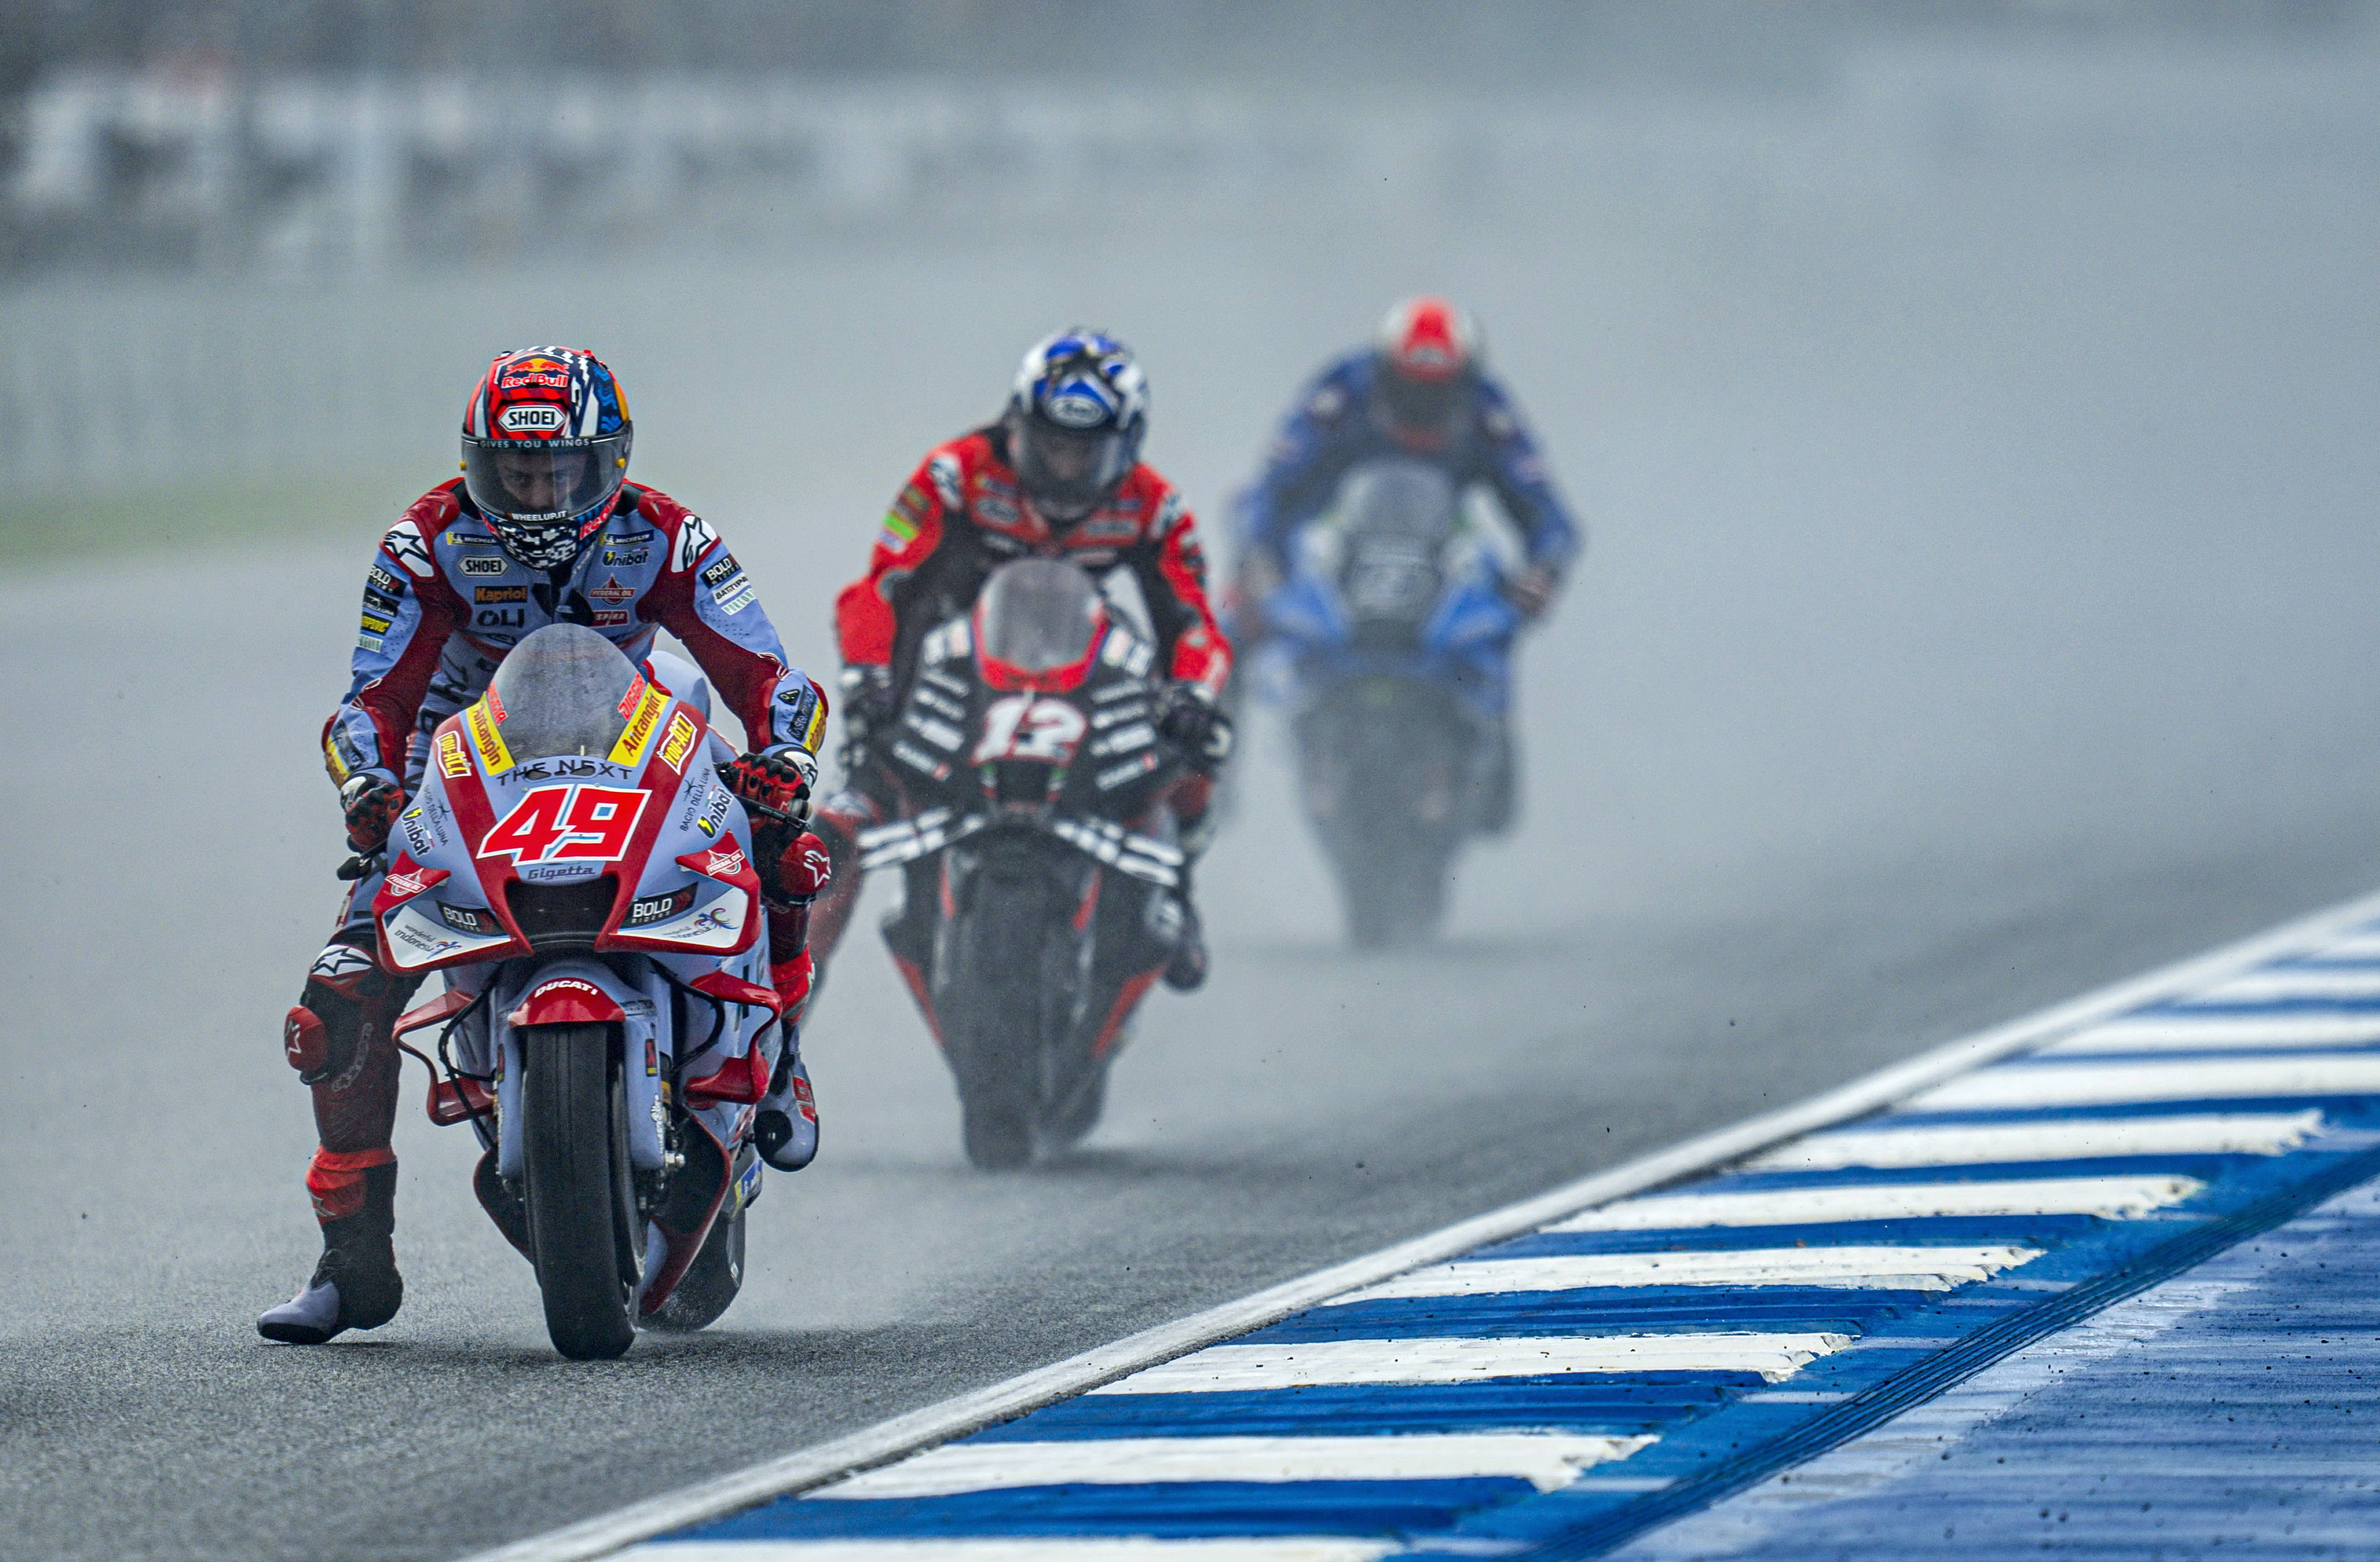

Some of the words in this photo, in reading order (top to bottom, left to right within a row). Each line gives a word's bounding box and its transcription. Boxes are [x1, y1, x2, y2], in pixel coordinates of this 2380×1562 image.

[501, 373, 534, 388] Red
[536, 374, 568, 387] Bull
[509, 411, 555, 426] SHOEI
[480, 440, 509, 448] GIVES
[549, 439, 590, 447] WINGS
[465, 559, 502, 572] SHOEI
[602, 550, 649, 566] Unibat
[706, 558, 732, 580] BOLD
[477, 609, 525, 628] OLI
[622, 694, 661, 757] Antangin
[663, 716, 694, 765] YOU-ALL
[440, 734, 468, 775] YOU-ALL
[497, 762, 546, 786] THE
[559, 759, 632, 780] NEXT
[680, 807, 696, 831] BACIO
[691, 782, 706, 807] DELLA
[701, 768, 711, 785] LUNA
[697, 787, 733, 840] Unibat
[402, 807, 433, 857] Unibat
[477, 784, 652, 866] 49
[528, 865, 595, 880] Gigetta
[709, 859, 731, 873] FEDERAL
[731, 853, 742, 862] OIL
[443, 906, 477, 926] BOLD
[631, 911, 671, 924] RIDERS
[633, 898, 672, 918] BOLD
[534, 980, 598, 998] DUCATI
